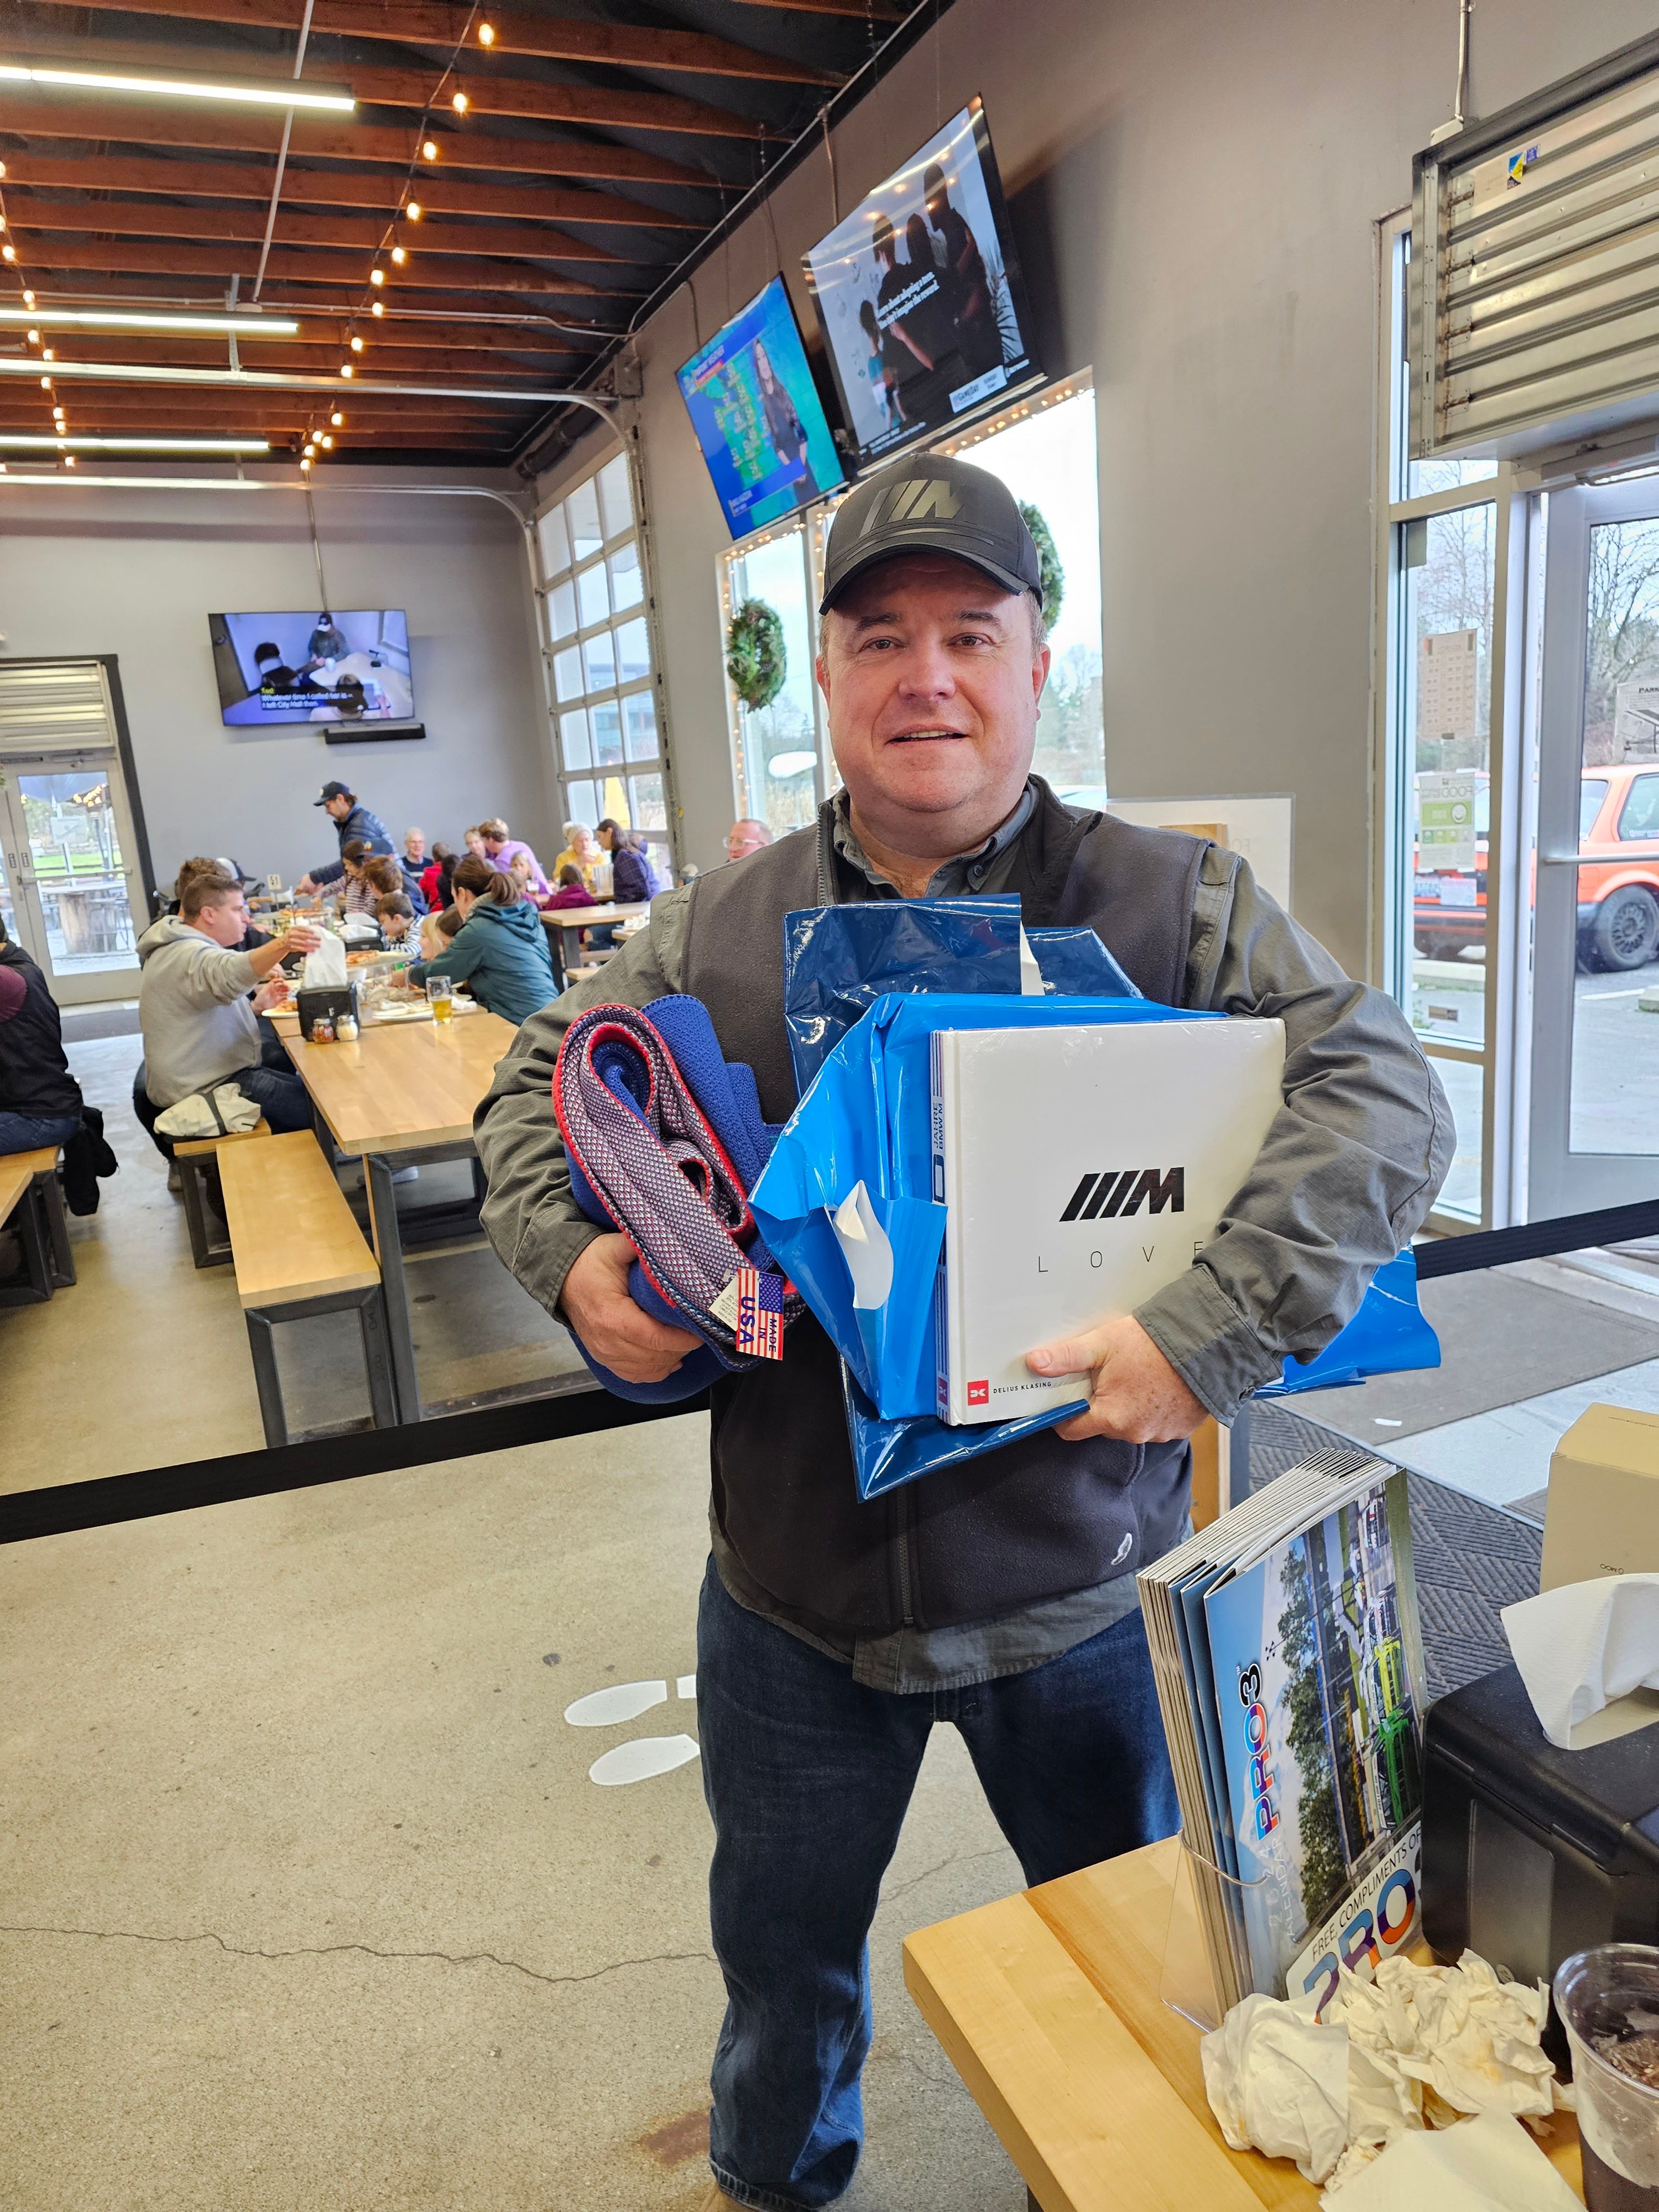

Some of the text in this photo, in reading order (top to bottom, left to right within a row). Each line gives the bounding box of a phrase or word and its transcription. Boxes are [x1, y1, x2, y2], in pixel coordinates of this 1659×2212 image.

[1038, 1241, 1204, 1272] LOVE
[739, 1296, 755, 1344] USA
[758, 1327, 766, 1339] IN
[769, 1318, 777, 1353] MADE
[993, 1381, 1052, 1394] DELIUS KLASING
[1238, 1662, 1280, 1843] PRO3
[1312, 1922, 1338, 1963] FREE
[1339, 1842, 1407, 1928] COMPLIMENTS
